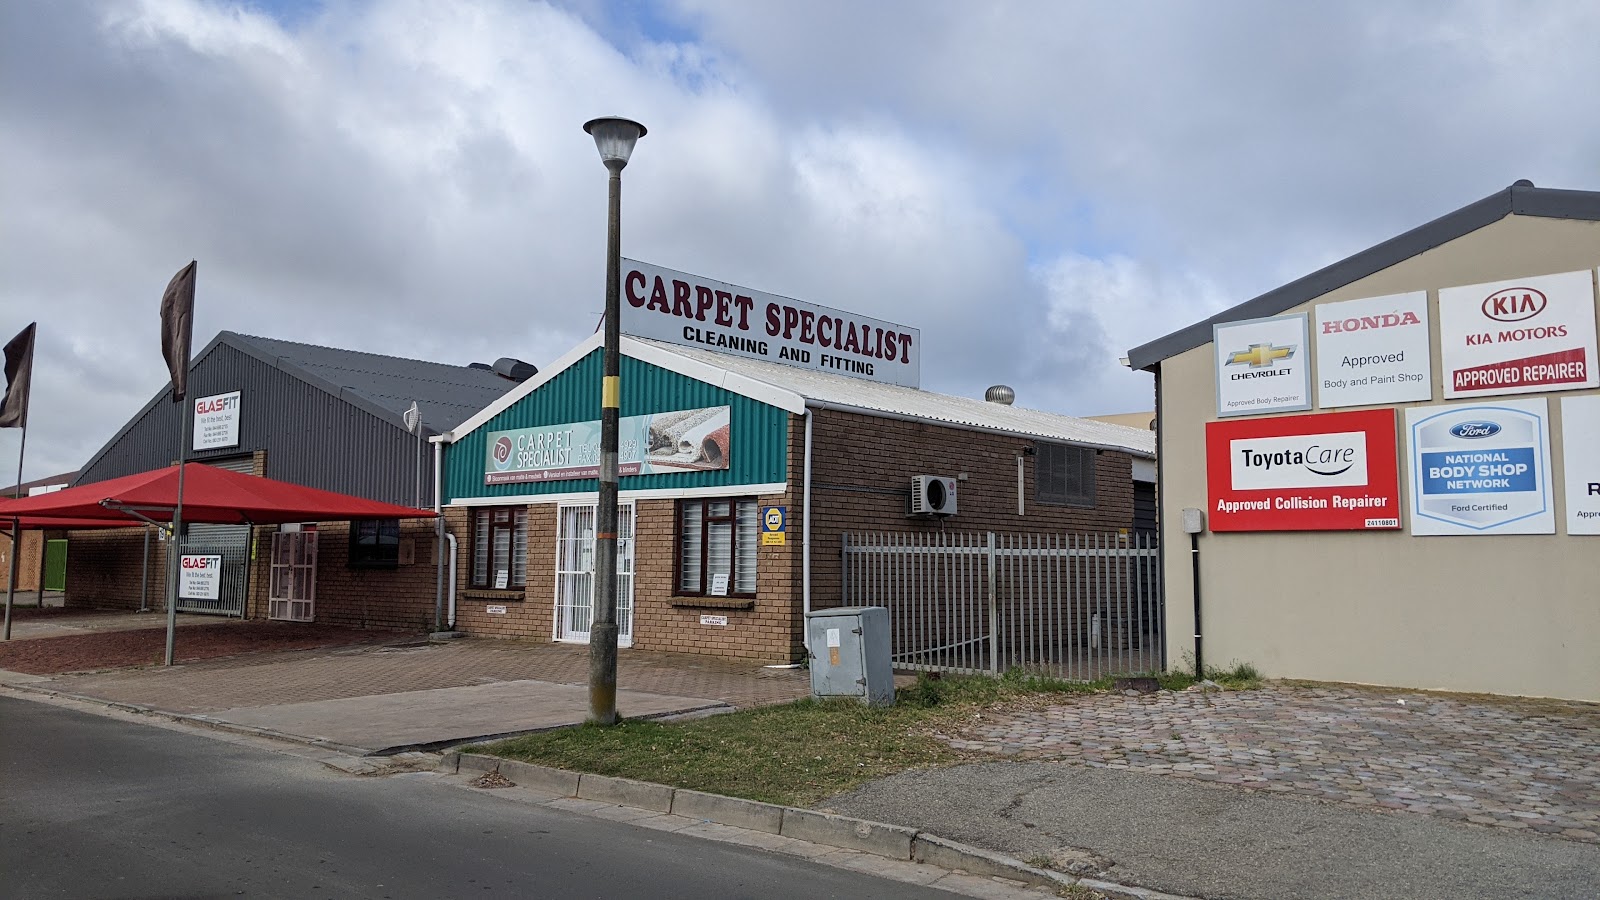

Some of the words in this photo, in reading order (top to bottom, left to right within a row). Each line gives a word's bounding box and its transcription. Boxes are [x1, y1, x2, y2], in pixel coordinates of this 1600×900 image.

[1492, 294, 1537, 316] KIA
[625, 270, 753, 330] CARPET
[765, 303, 912, 364] SPECIALIST
[1323, 312, 1420, 334] HONDA
[1466, 333, 1493, 346] KIA
[1498, 325, 1568, 343] MOTORS
[683, 326, 768, 355] CLEANING
[779, 346, 811, 363] AND
[821, 355, 874, 376] FITTING
[1341, 351, 1404, 368] Approved
[1231, 368, 1292, 380] CHEVROLET
[1324, 379, 1347, 389] Body
[1350, 377, 1367, 386] and
[1370, 375, 1395, 384] Paint
[1398, 373, 1424, 383] Shop
[1455, 367, 1519, 387] APPROVED
[1523, 362, 1585, 382] REPAIRER
[196, 395, 239, 414] GLASFIT
[1227, 398, 1255, 407] Approved
[1257, 397, 1272, 405] Body
[1273, 395, 1300, 403] Repairer
[1460, 423, 1491, 437] Ford
[517, 430, 573, 451] CARPET
[517, 448, 572, 469] SPECIALIST
[1445, 453, 1509, 464] NATIONAL
[1429, 466, 1475, 479] BODY
[1478, 464, 1528, 476] SHOP
[1447, 479, 1510, 489] NETWORK
[1217, 497, 1270, 513] Approved
[1275, 496, 1327, 510] Collision
[1332, 495, 1387, 510] Repairer
[1451, 504, 1470, 512] Ford
[1472, 503, 1508, 512] Certified
[182, 557, 219, 569] GLASFIT
